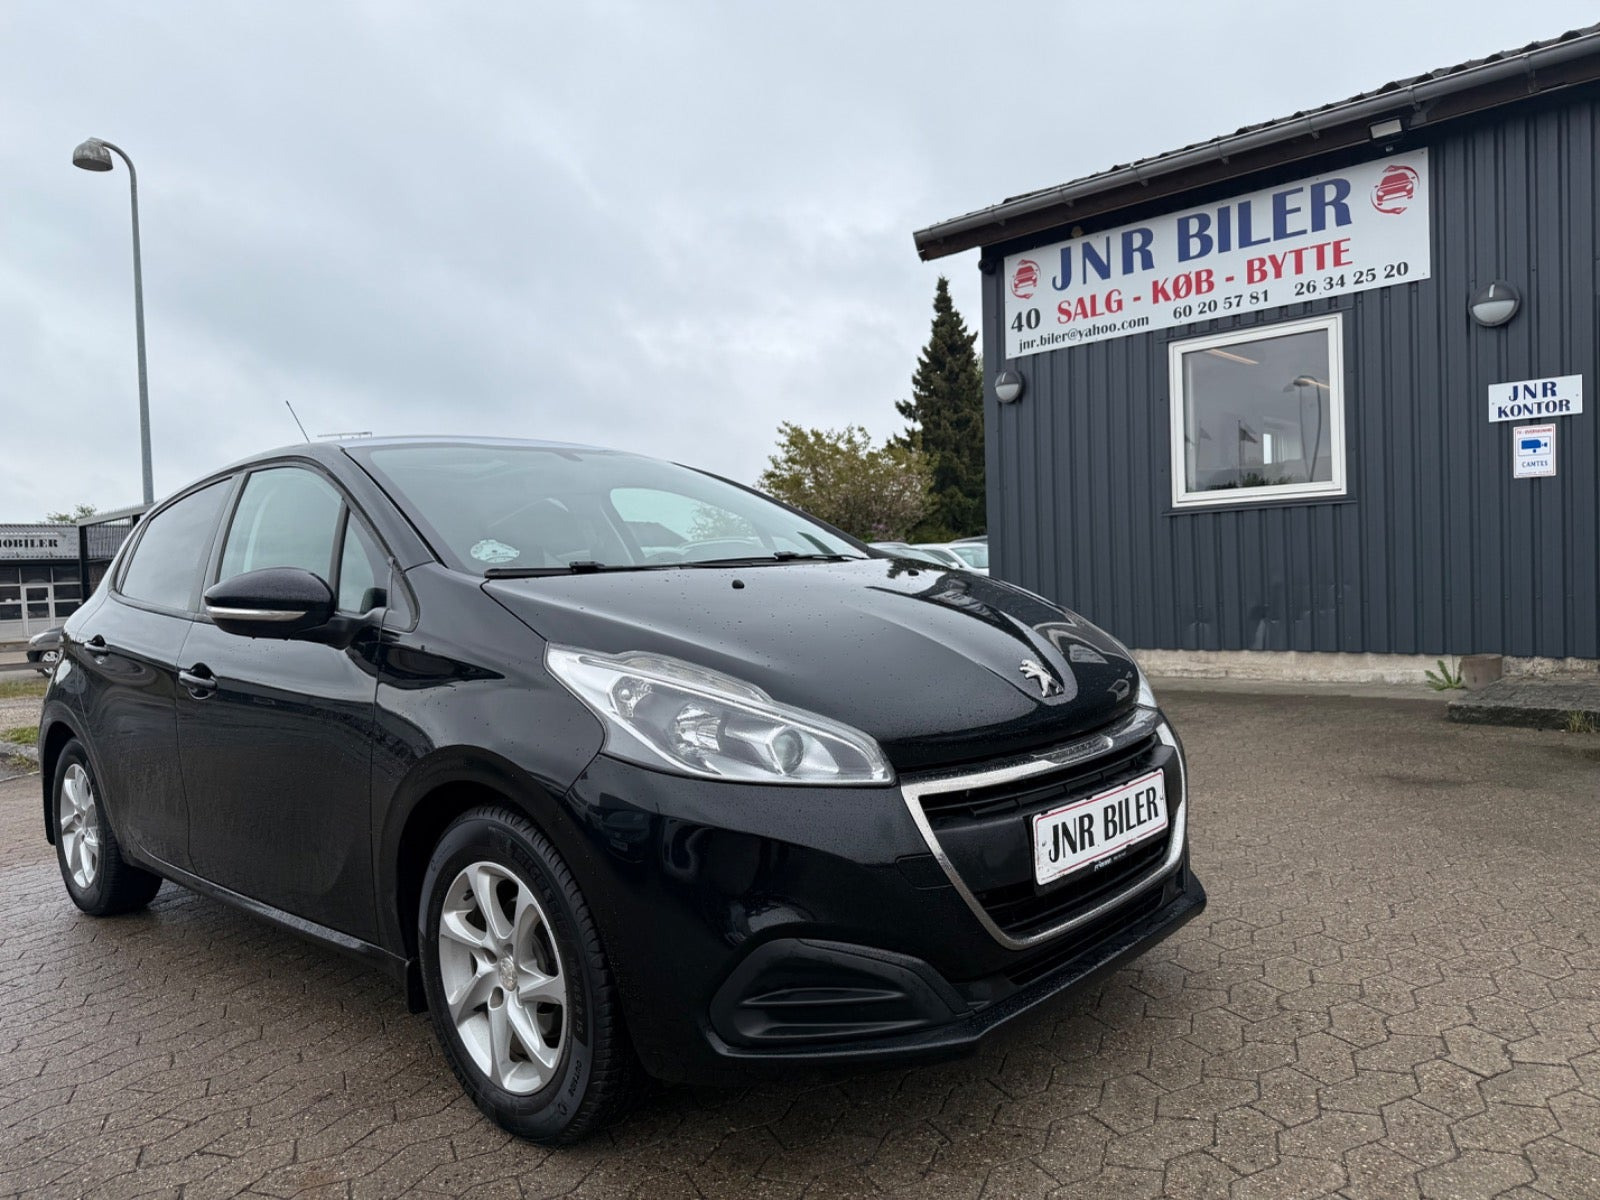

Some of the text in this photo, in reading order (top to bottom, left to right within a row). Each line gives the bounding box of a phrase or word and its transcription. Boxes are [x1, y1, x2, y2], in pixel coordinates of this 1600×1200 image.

[1052, 178, 1353, 291] JNR BILER
[1057, 288, 1123, 324] SALG
[1152, 268, 1215, 305] KØB
[1246, 238, 1353, 285] BYTTE
[1011, 308, 1041, 333] 40
[1019, 261, 1409, 353] jnr.biler@yahoo.com 60 20 57 81 26 34 25 20
[1498, 399, 1570, 418] KONTOR
[1509, 381, 1557, 401] JNR
[0, 539, 58, 548] OBILER
[1049, 813, 1095, 862] JNR
[1103, 786, 1159, 841] BILER
